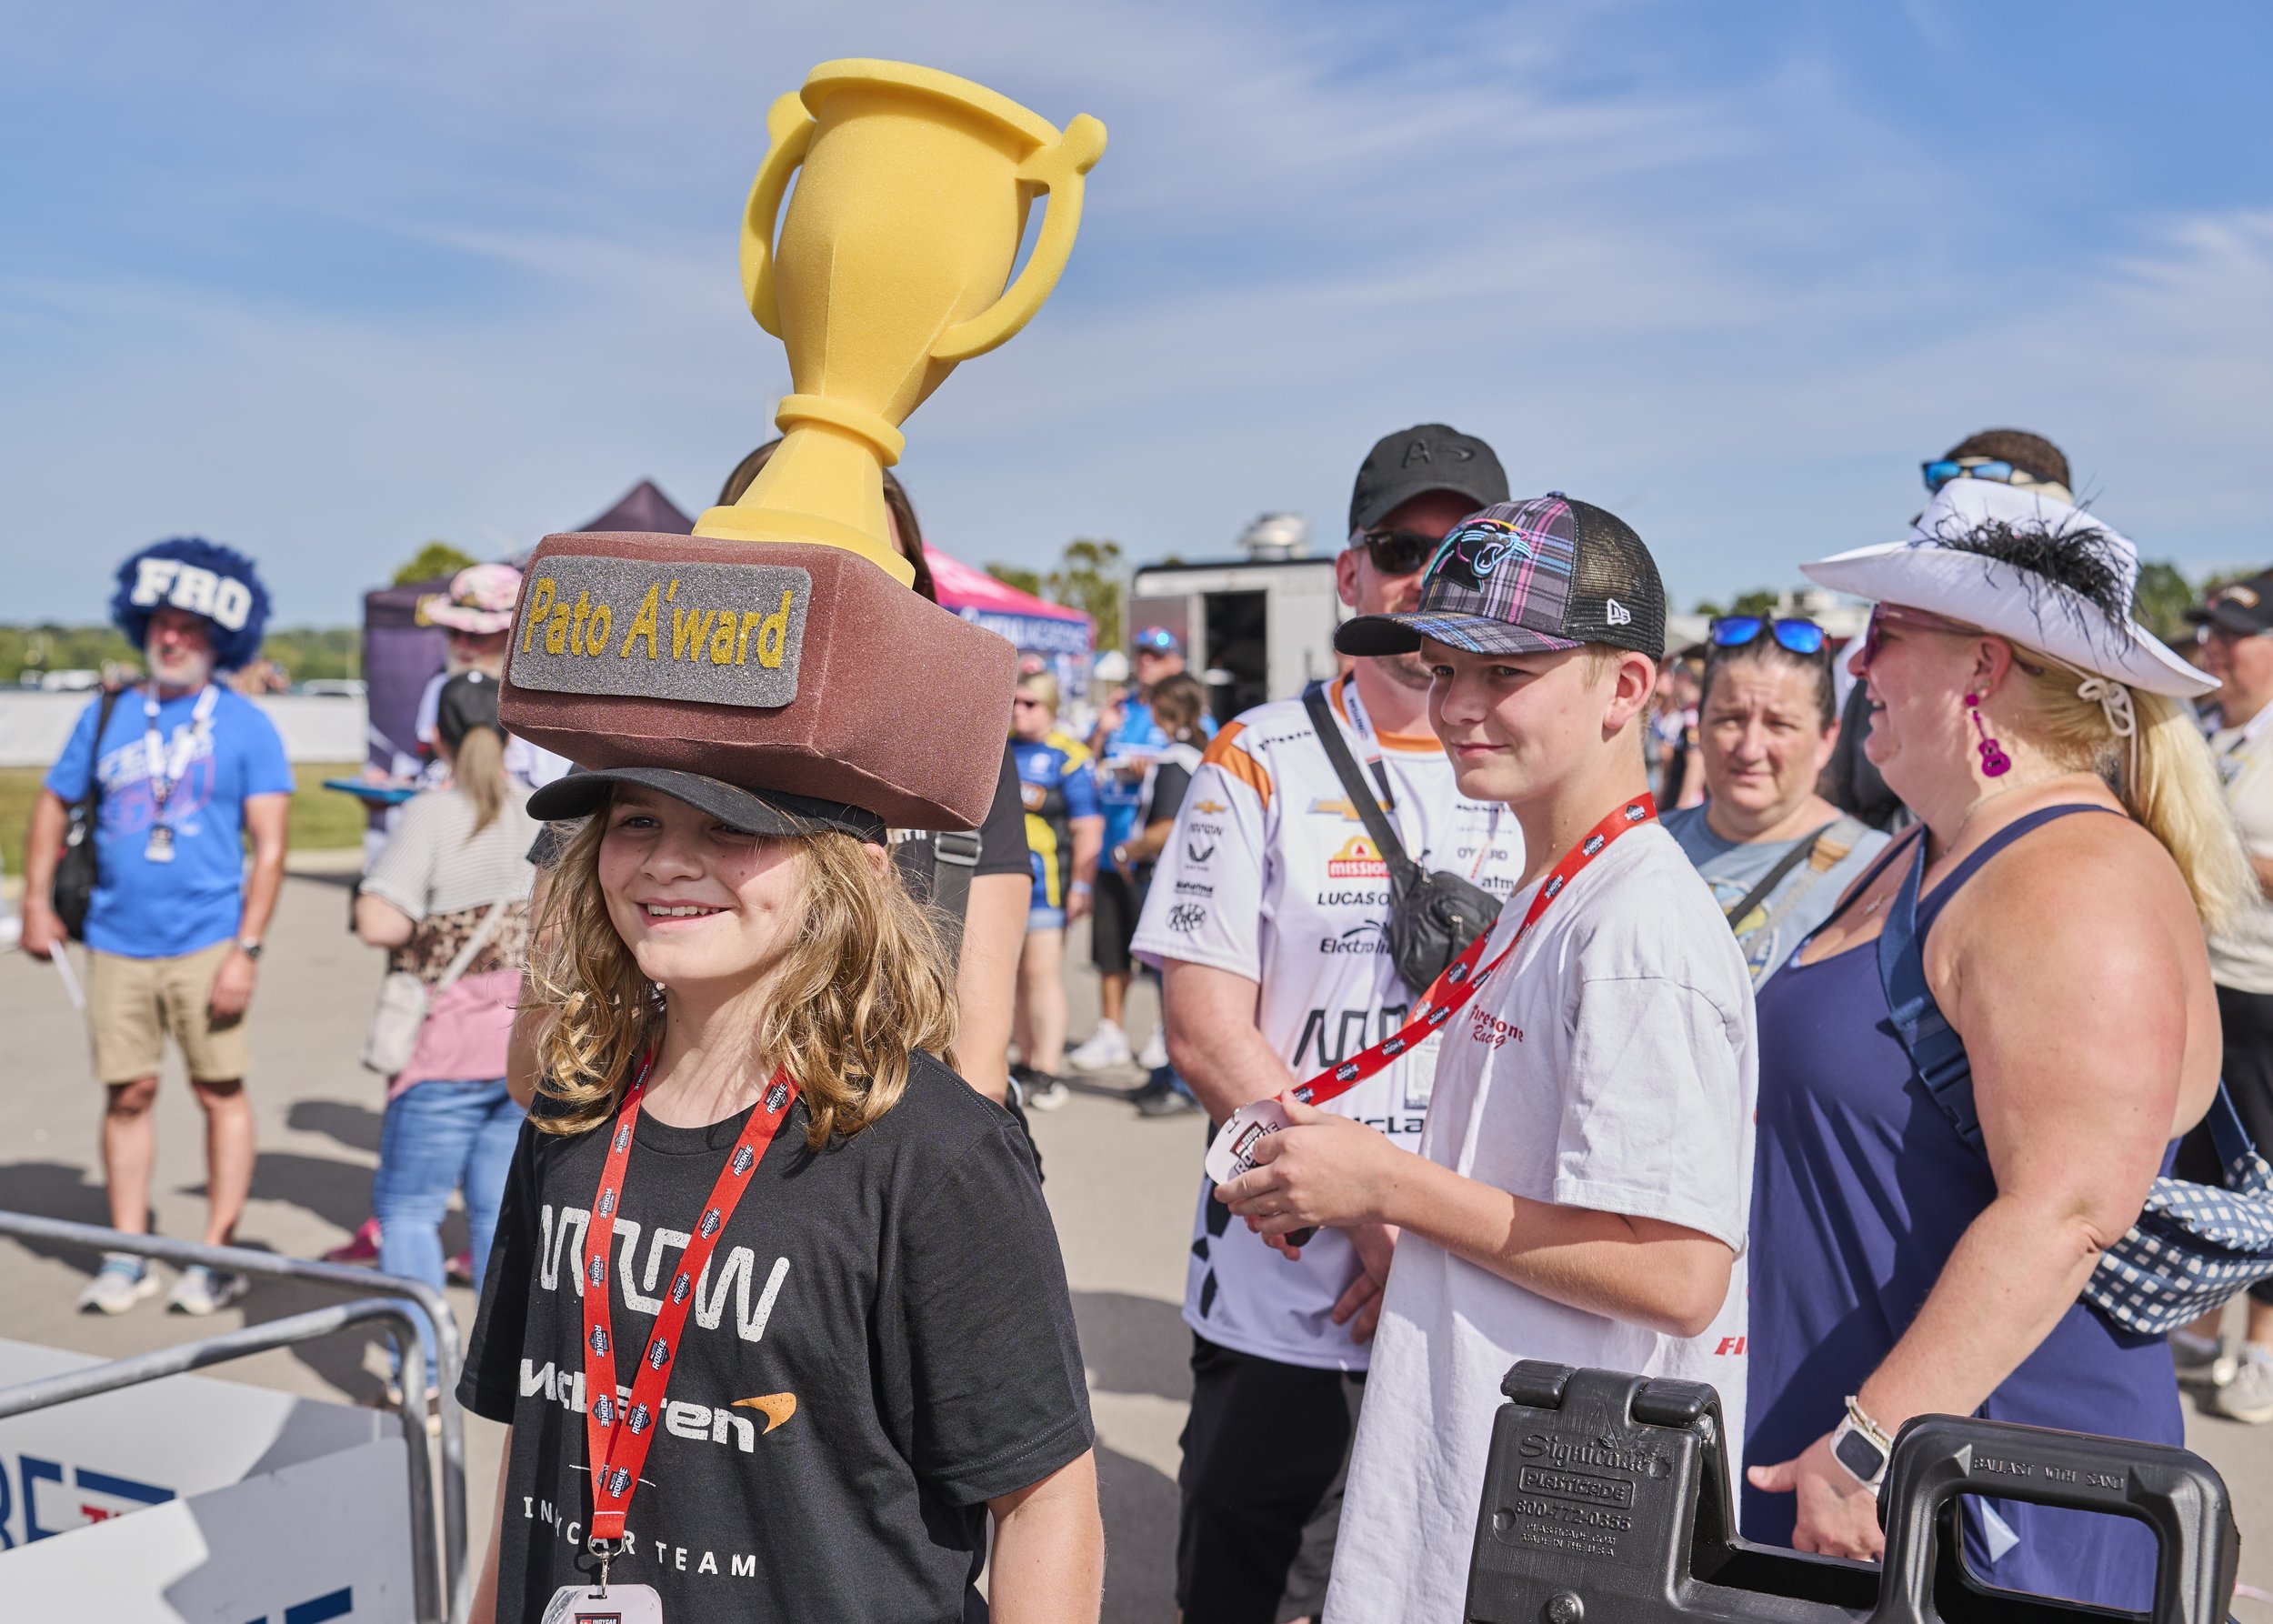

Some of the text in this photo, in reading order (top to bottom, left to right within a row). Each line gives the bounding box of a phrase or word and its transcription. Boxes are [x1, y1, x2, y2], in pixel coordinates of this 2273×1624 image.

[129, 556, 254, 631] FRO
[522, 577, 612, 657] Pato
[619, 578, 794, 669] A'ward
[1582, 834, 1605, 857] ROOKIE
[1317, 892, 1375, 906] LUCAS
[1545, 874, 1564, 899] ROOKIE
[1427, 1006, 1451, 1026] ROOKIE
[1382, 1038, 1406, 1056] ROOKIE
[1336, 1064, 1359, 1082] ROOKIE
[766, 1082, 788, 1115] ROOKIE
[616, 1124, 628, 1154] ROOKIE
[734, 1144, 754, 1177] ROOKIE
[599, 1188, 613, 1219] ROOKIE
[700, 1207, 722, 1240] ROOKIE
[592, 1255, 602, 1288] ROOKIE
[673, 1271, 690, 1306] ROOKIE
[594, 1324, 605, 1358] ROOKIE
[651, 1337, 667, 1370] ROOKIE
[599, 1394, 610, 1428] ROOKIE
[631, 1402, 647, 1435] ROOKIE
[612, 1467, 628, 1499] ROOKIE
[1974, 1458, 2125, 1491] BALLAST WITH SAND
[1516, 1499, 1632, 1532] 800-772-0355
[1521, 1532, 1549, 1545] MADE
[1553, 1538, 1564, 1548] IN
[1567, 1540, 1585, 1551] THE
[1527, 1522, 1617, 1546] PLASTICADE.COM
[655, 1540, 756, 1578] TEAM
